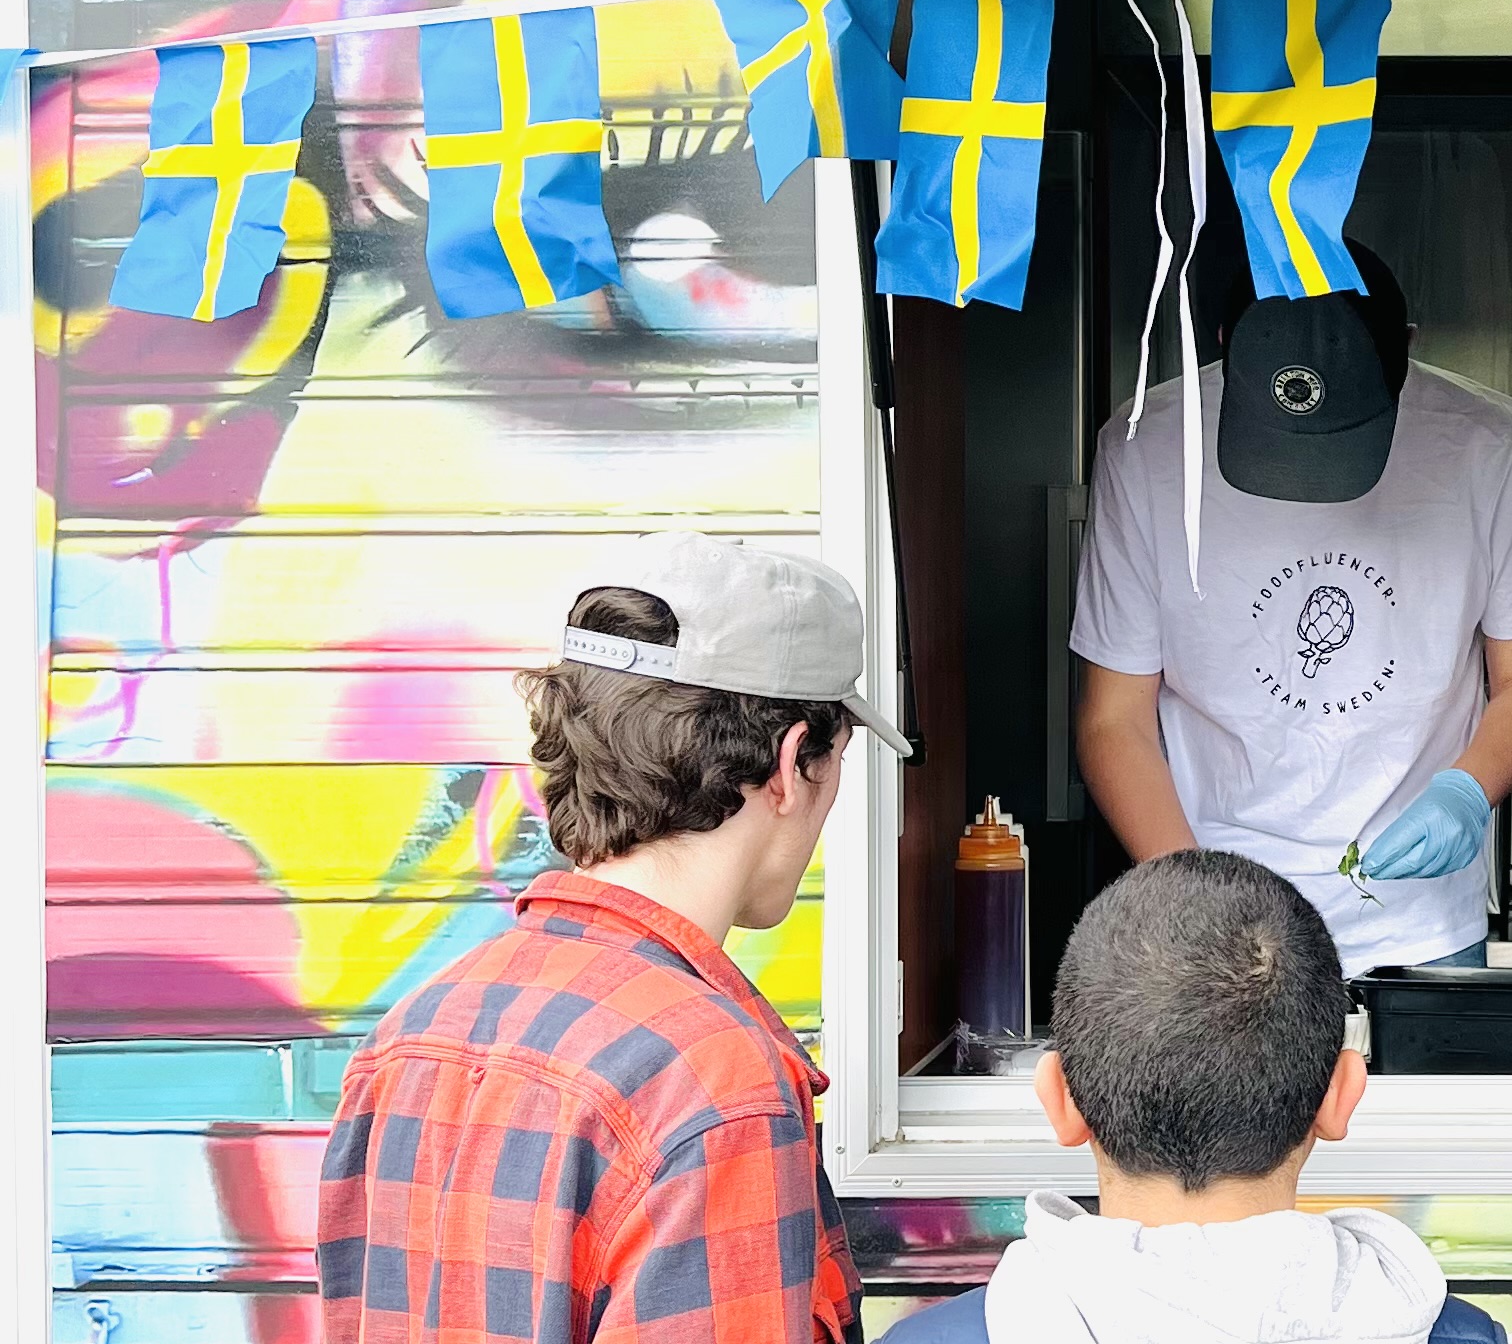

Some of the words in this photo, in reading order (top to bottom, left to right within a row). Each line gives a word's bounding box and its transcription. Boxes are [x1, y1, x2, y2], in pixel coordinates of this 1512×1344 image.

[1252, 551, 1394, 612] FOODFLUENCER
[1261, 673, 1307, 711] TEAM
[1322, 666, 1394, 715] SWEDEN
